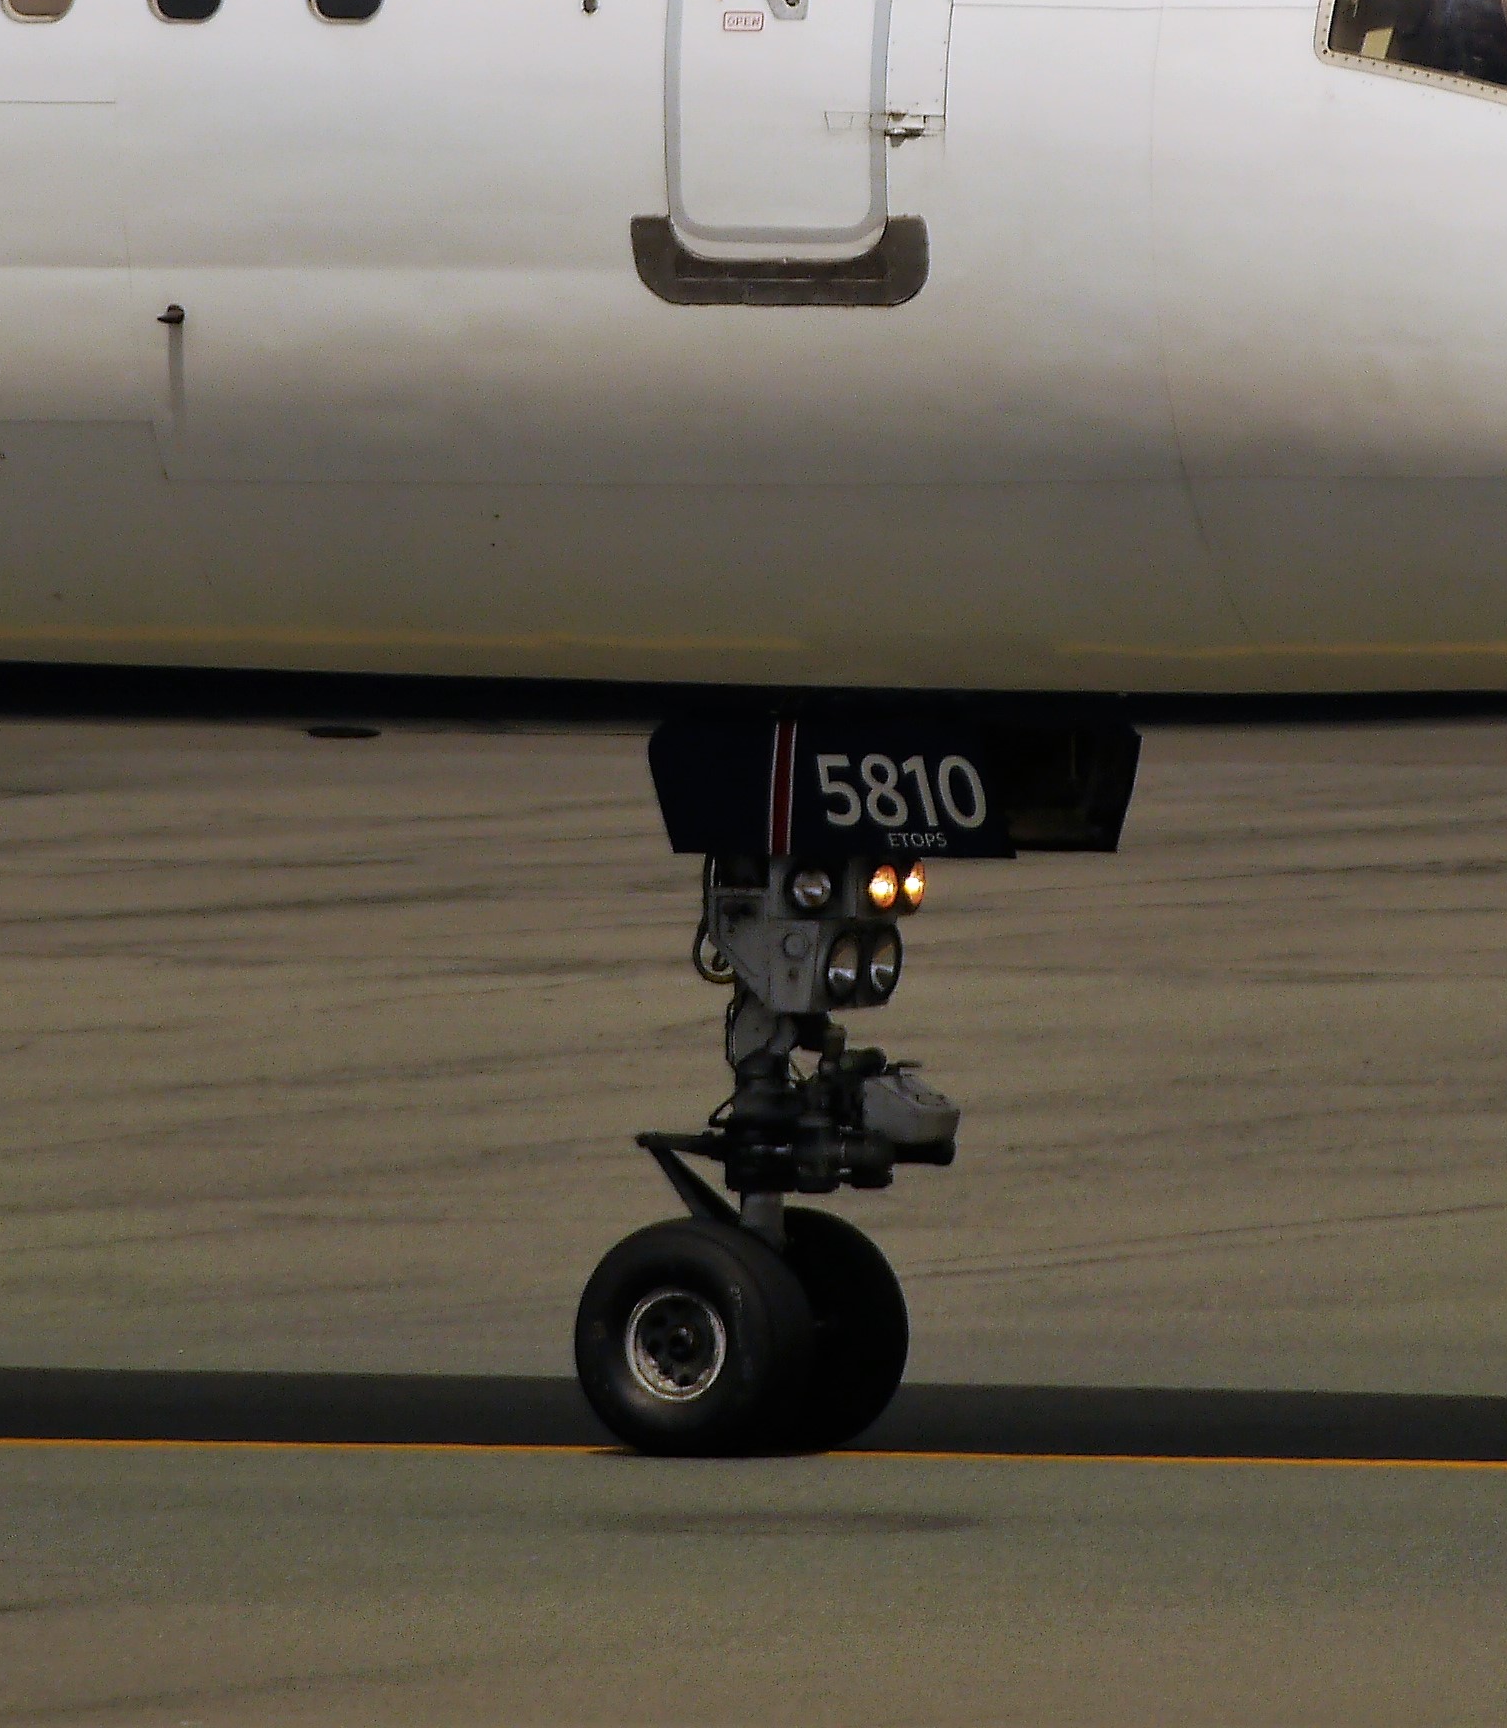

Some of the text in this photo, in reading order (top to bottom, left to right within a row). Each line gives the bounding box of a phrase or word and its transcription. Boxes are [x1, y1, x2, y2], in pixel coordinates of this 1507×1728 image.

[727, 16, 760, 27] OPEN
[816, 753, 987, 829] 5810
[888, 833, 948, 848] ETOPS
